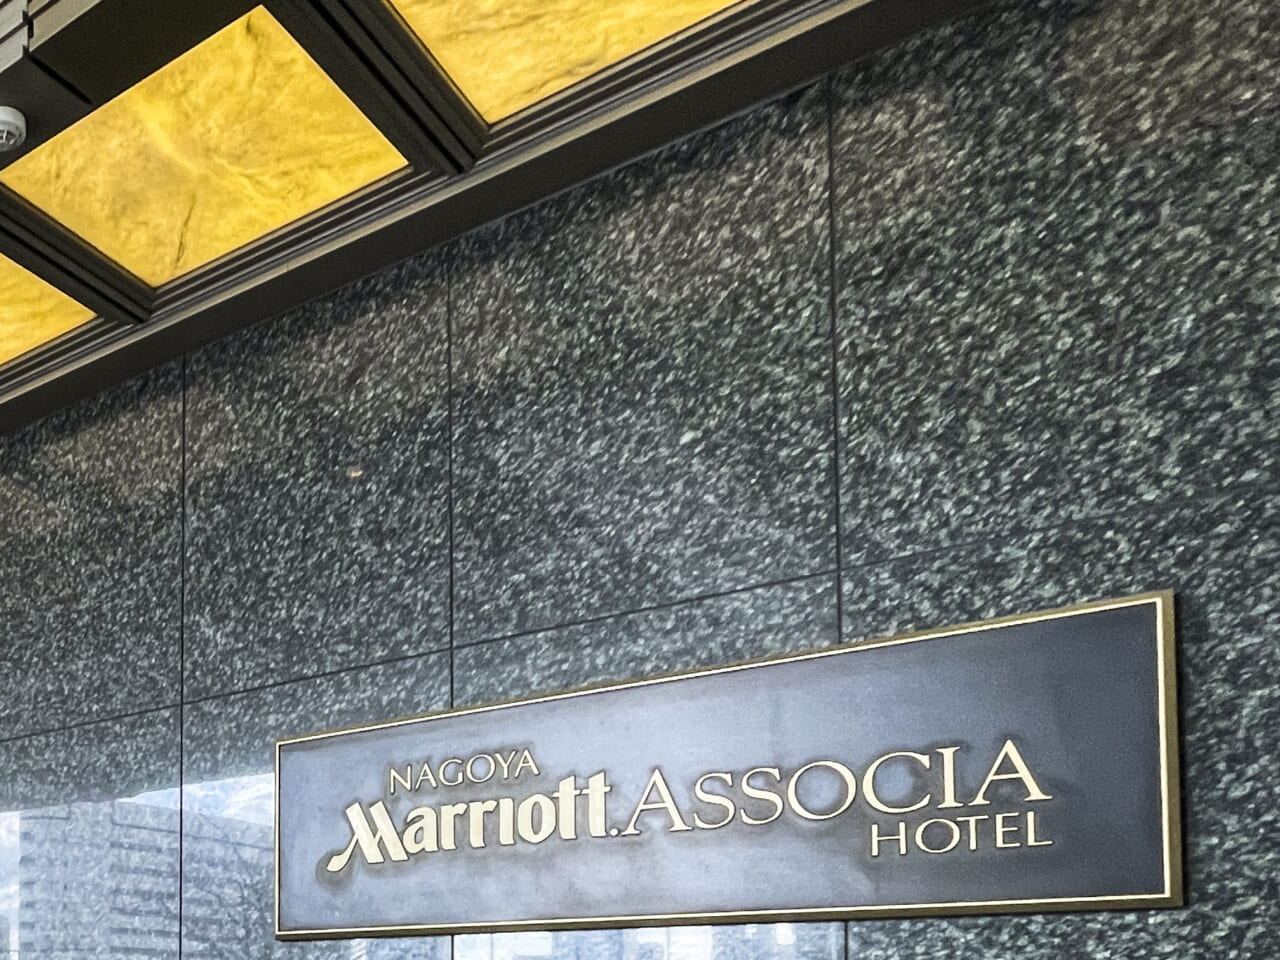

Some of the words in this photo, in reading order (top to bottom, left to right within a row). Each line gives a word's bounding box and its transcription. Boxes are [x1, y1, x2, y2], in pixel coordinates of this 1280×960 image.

[389, 749, 540, 795] NAGOYA
[622, 738, 1053, 836] ASSOCIA
[870, 811, 1053, 857] HOTEL
